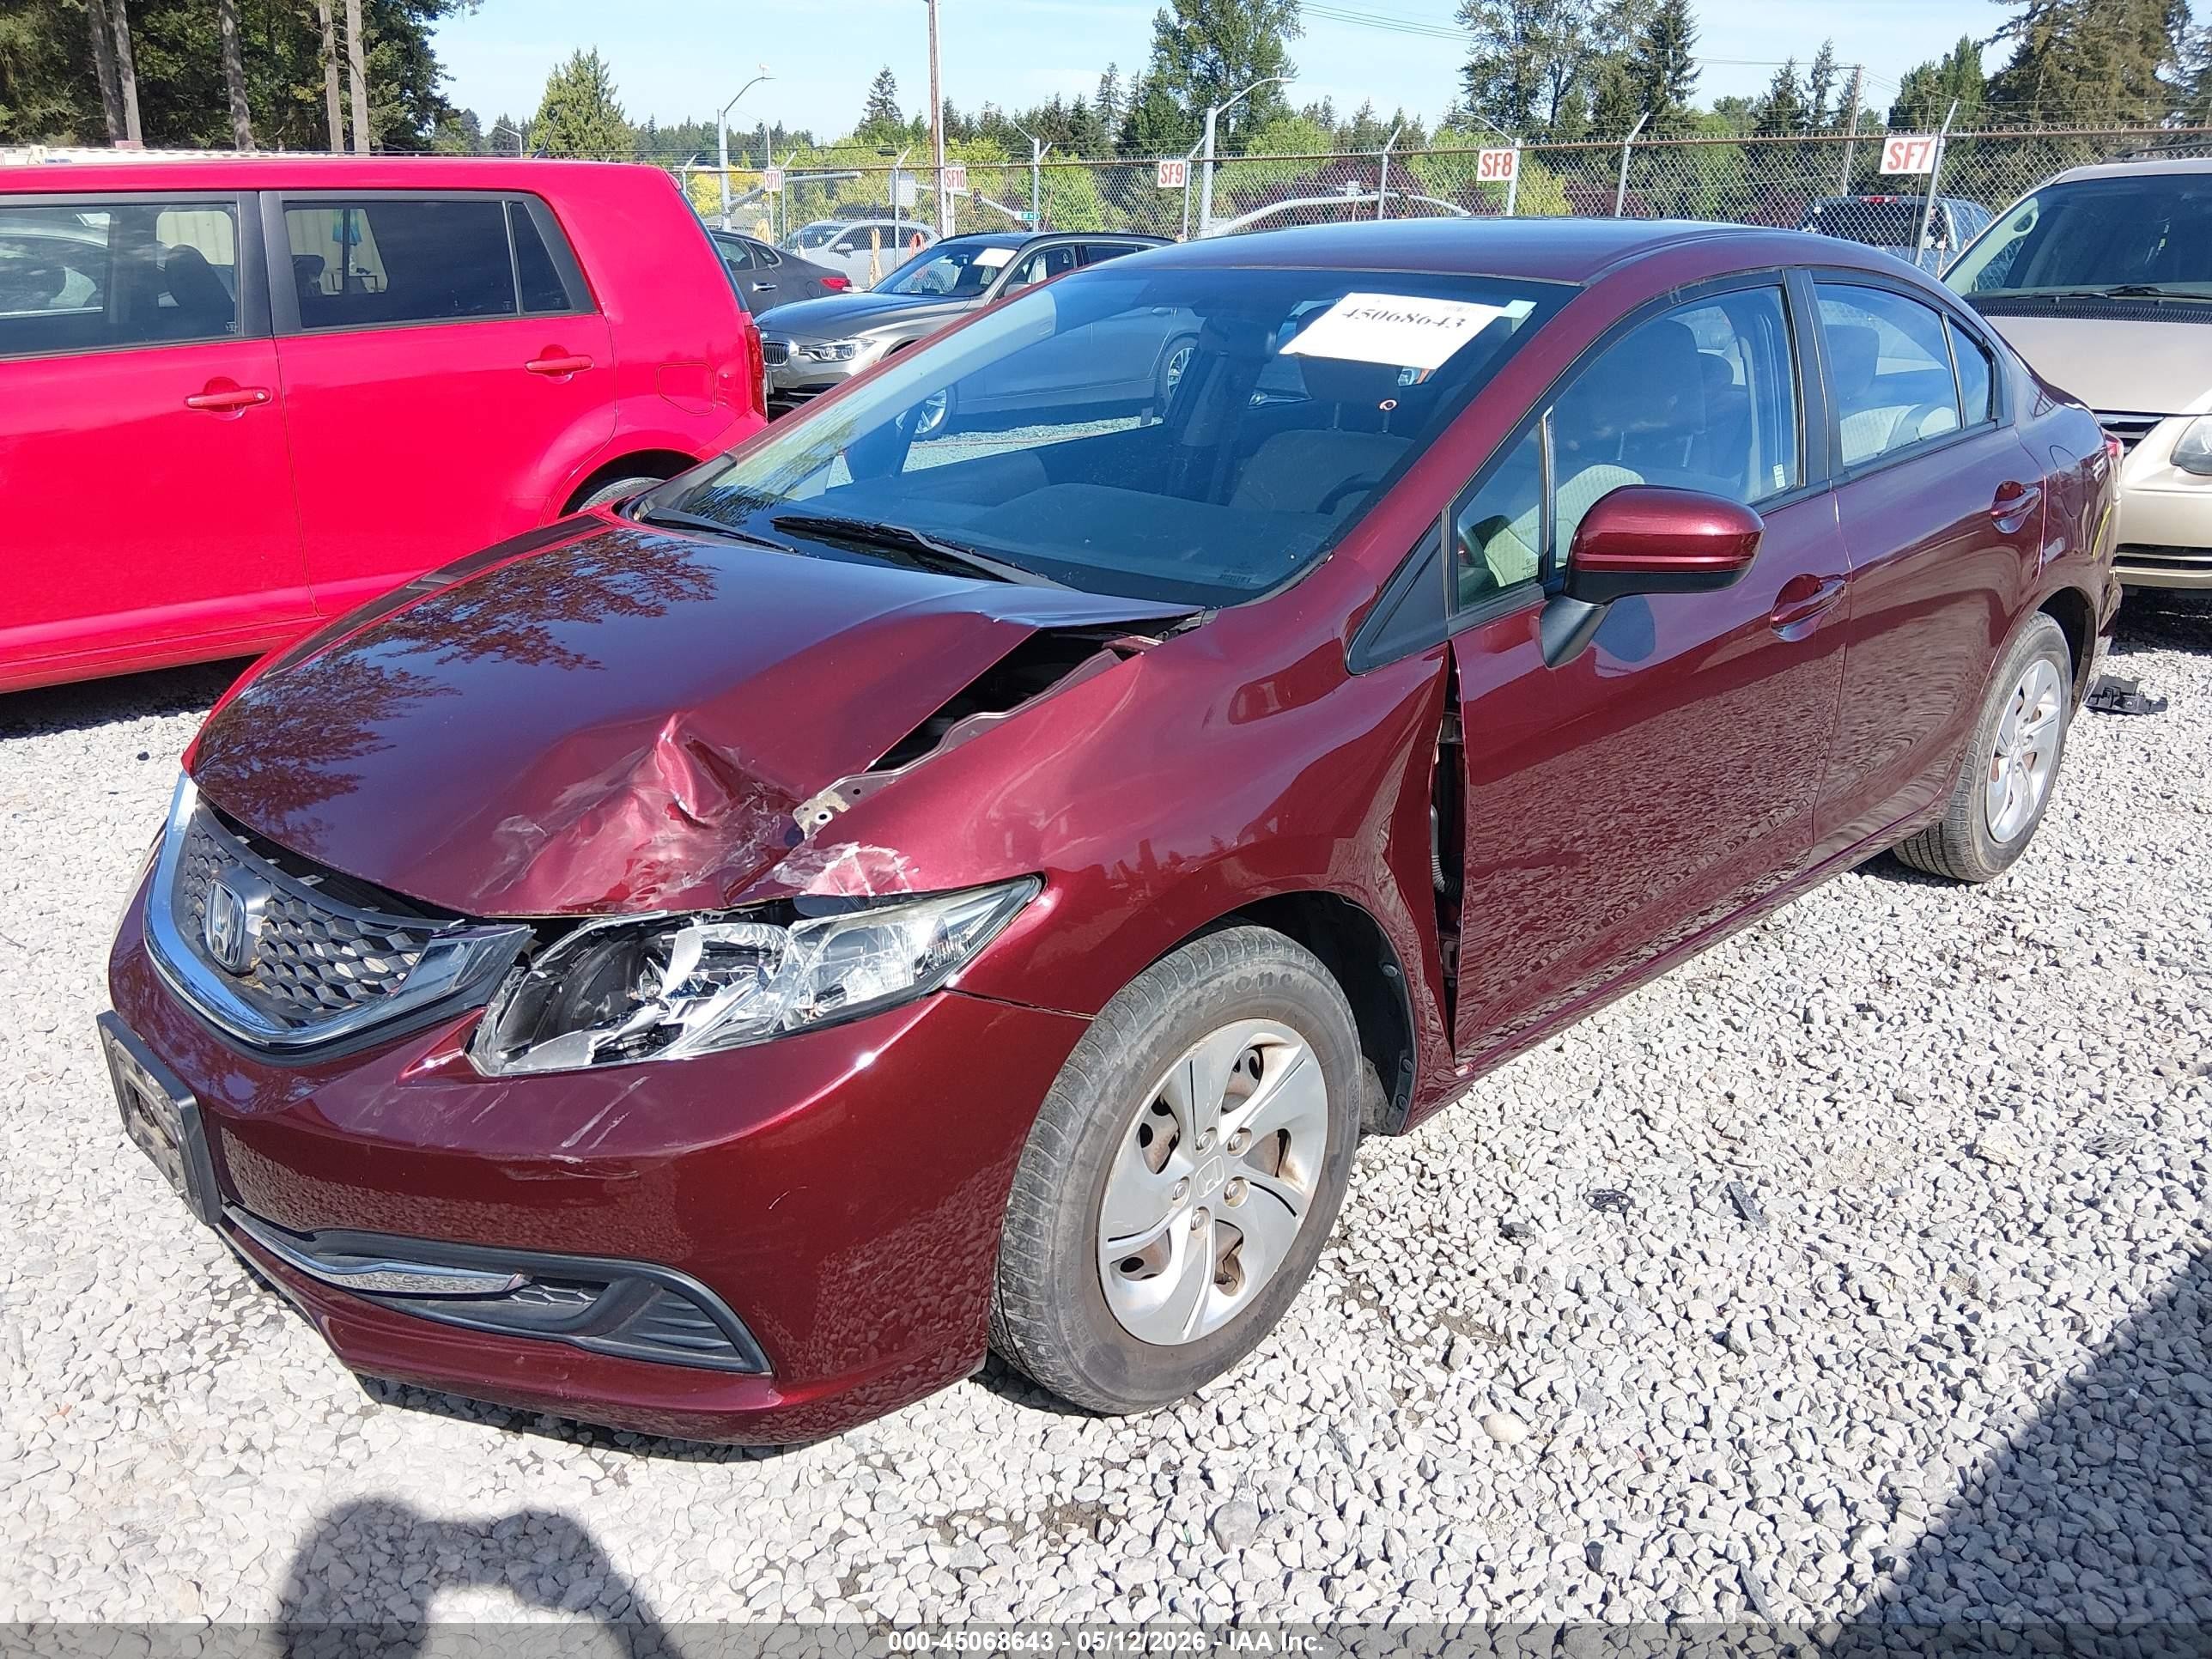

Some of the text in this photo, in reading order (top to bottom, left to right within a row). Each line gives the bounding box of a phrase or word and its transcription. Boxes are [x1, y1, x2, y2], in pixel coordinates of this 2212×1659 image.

[1481, 152, 1513, 178] SF8
[1887, 142, 1931, 171] SF7
[766, 173, 780, 189] SF11
[946, 169, 965, 188] SF10
[1160, 163, 1183, 184] SF9
[1341, 307, 1467, 330] 45068643
